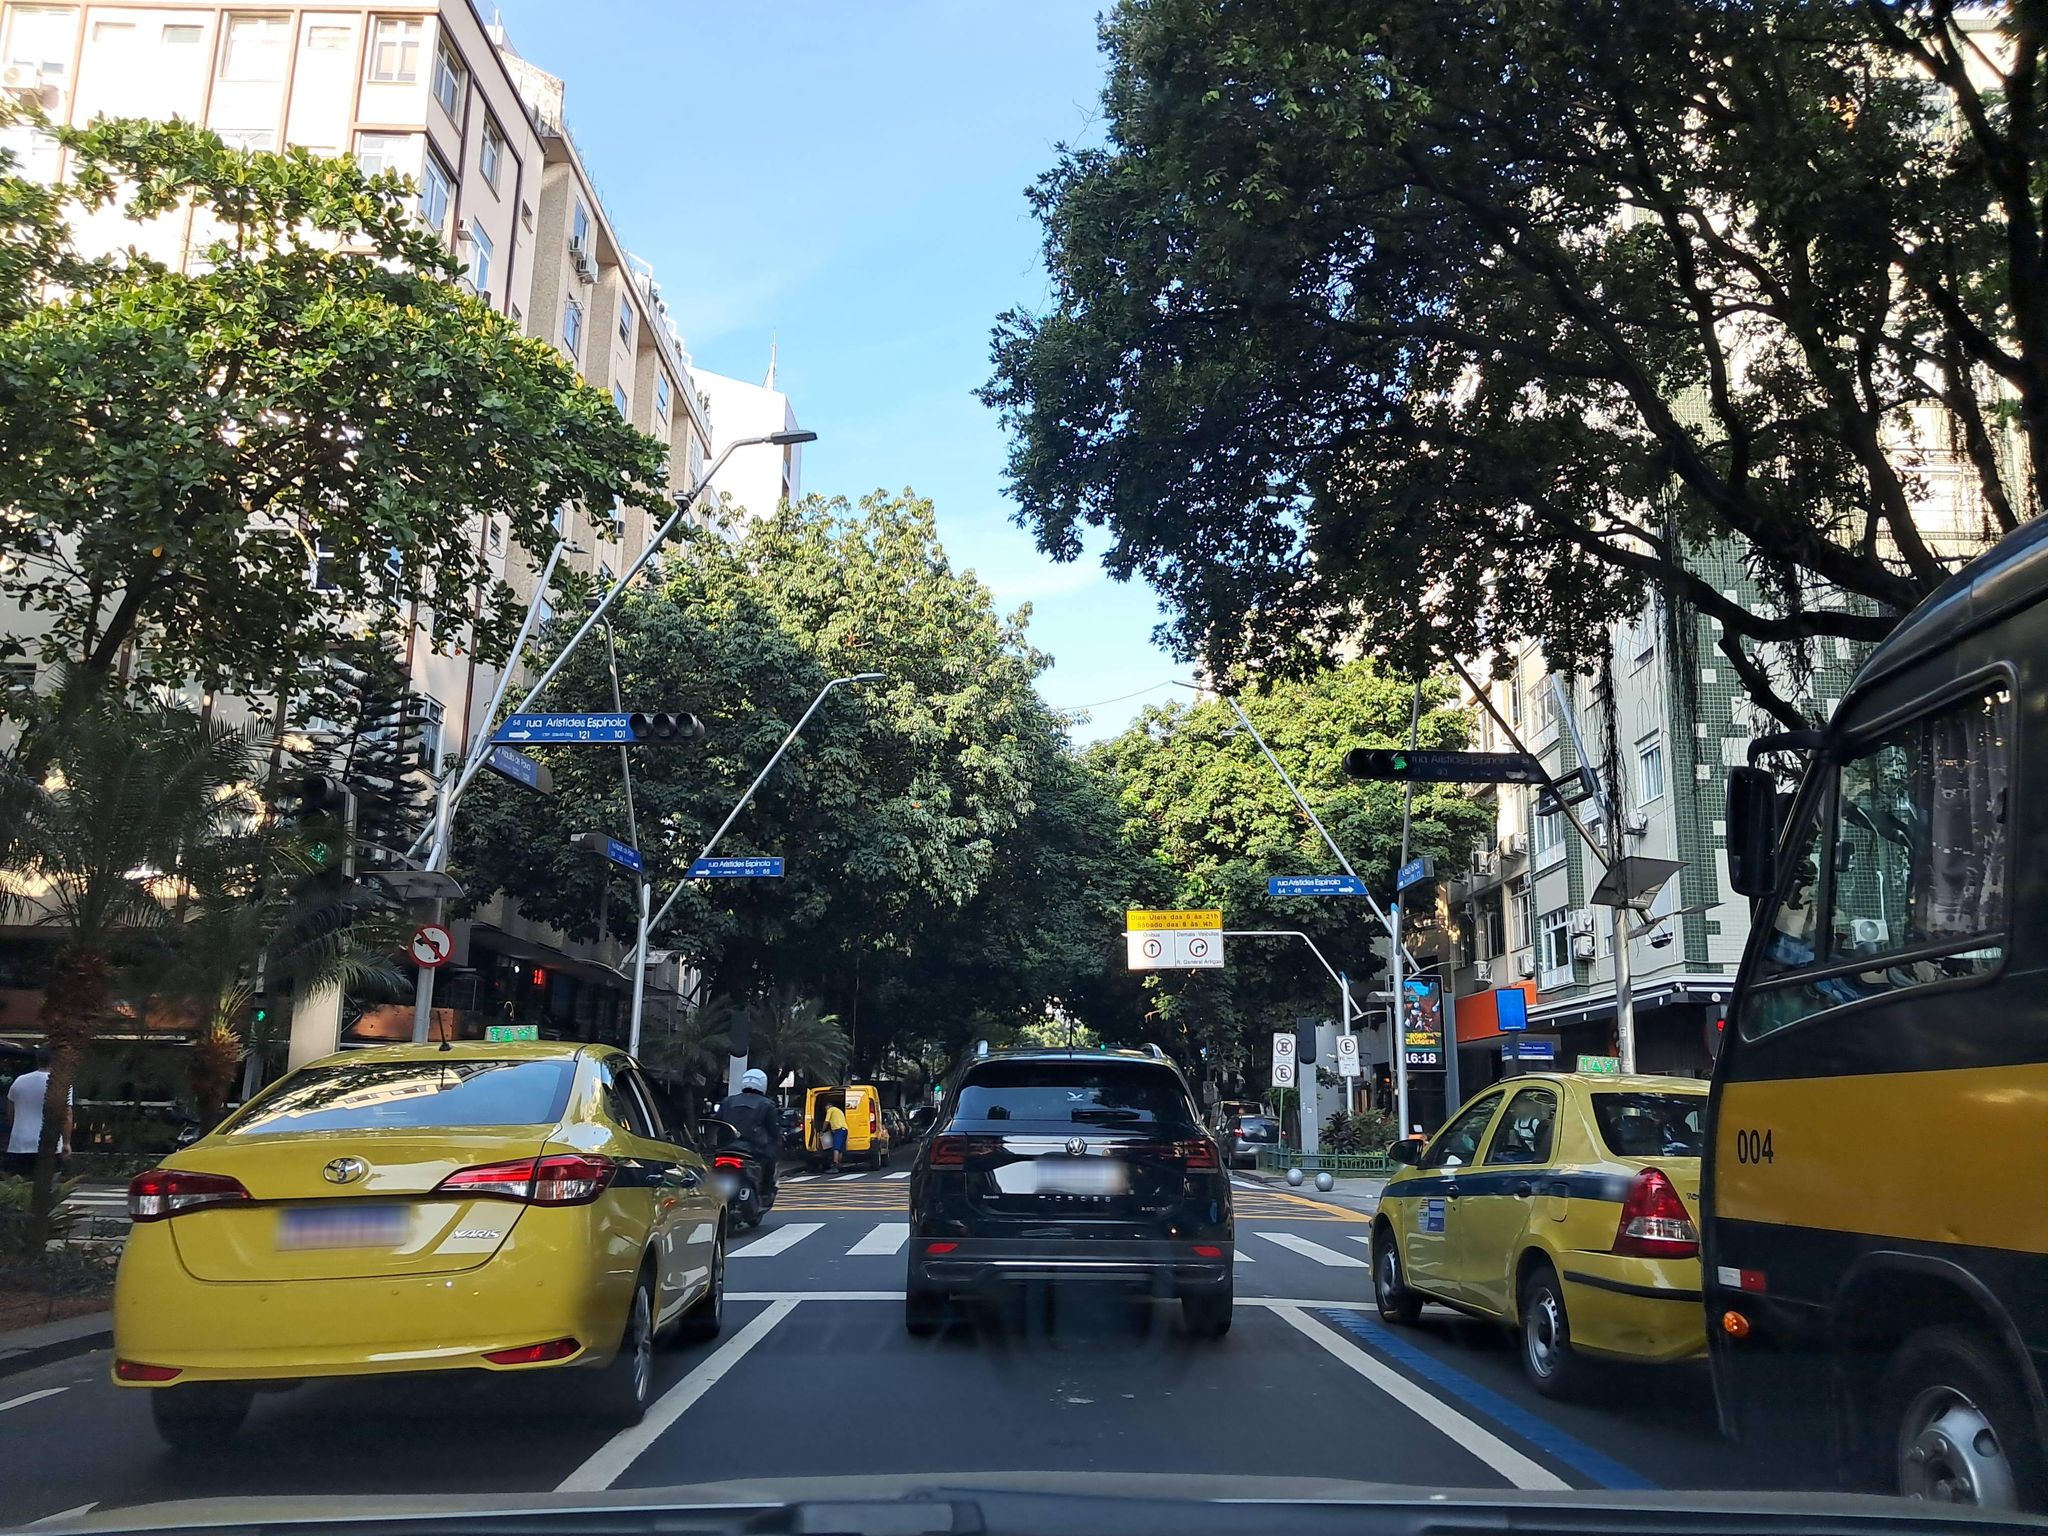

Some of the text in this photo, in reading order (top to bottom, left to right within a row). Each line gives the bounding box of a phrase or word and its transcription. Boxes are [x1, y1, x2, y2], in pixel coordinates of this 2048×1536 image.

[526, 719, 543, 728] rua
[545, 717, 585, 728] Aristides
[578, 730, 590, 740] 121
[614, 730, 626, 739] 101
[719, 860, 745, 868] Aristides
[1405, 1052, 1437, 1064] 16:18
[1737, 1129, 1774, 1164] 004
[453, 1230, 501, 1239] YARIS
